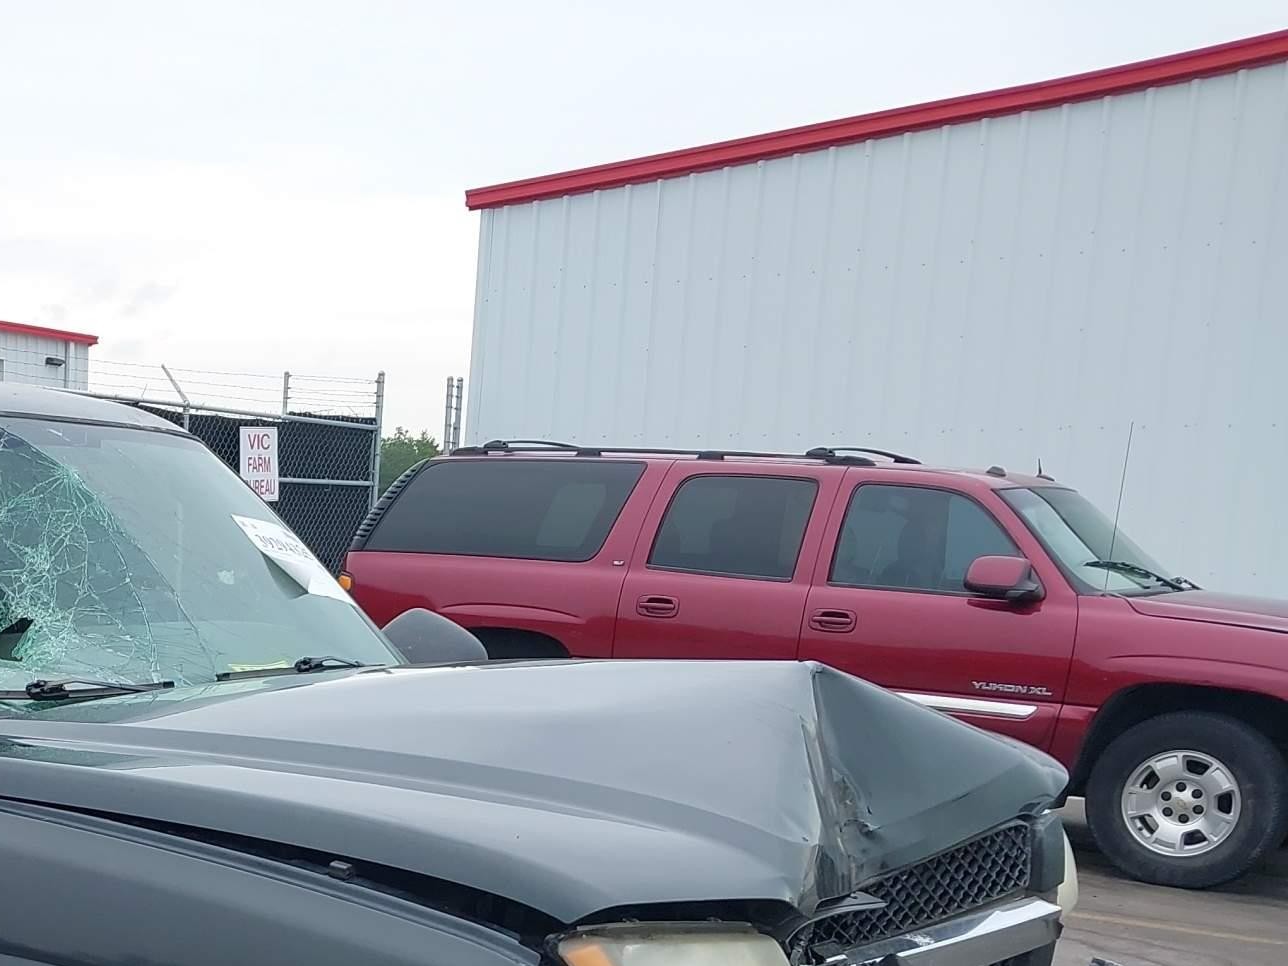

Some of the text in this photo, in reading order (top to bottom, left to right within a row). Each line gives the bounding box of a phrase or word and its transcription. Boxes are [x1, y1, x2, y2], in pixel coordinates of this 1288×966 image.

[247, 433, 271, 450] VIC
[247, 456, 272, 473] FARM
[245, 479, 276, 496] UREAU
[971, 681, 1053, 696] YUKON XL
